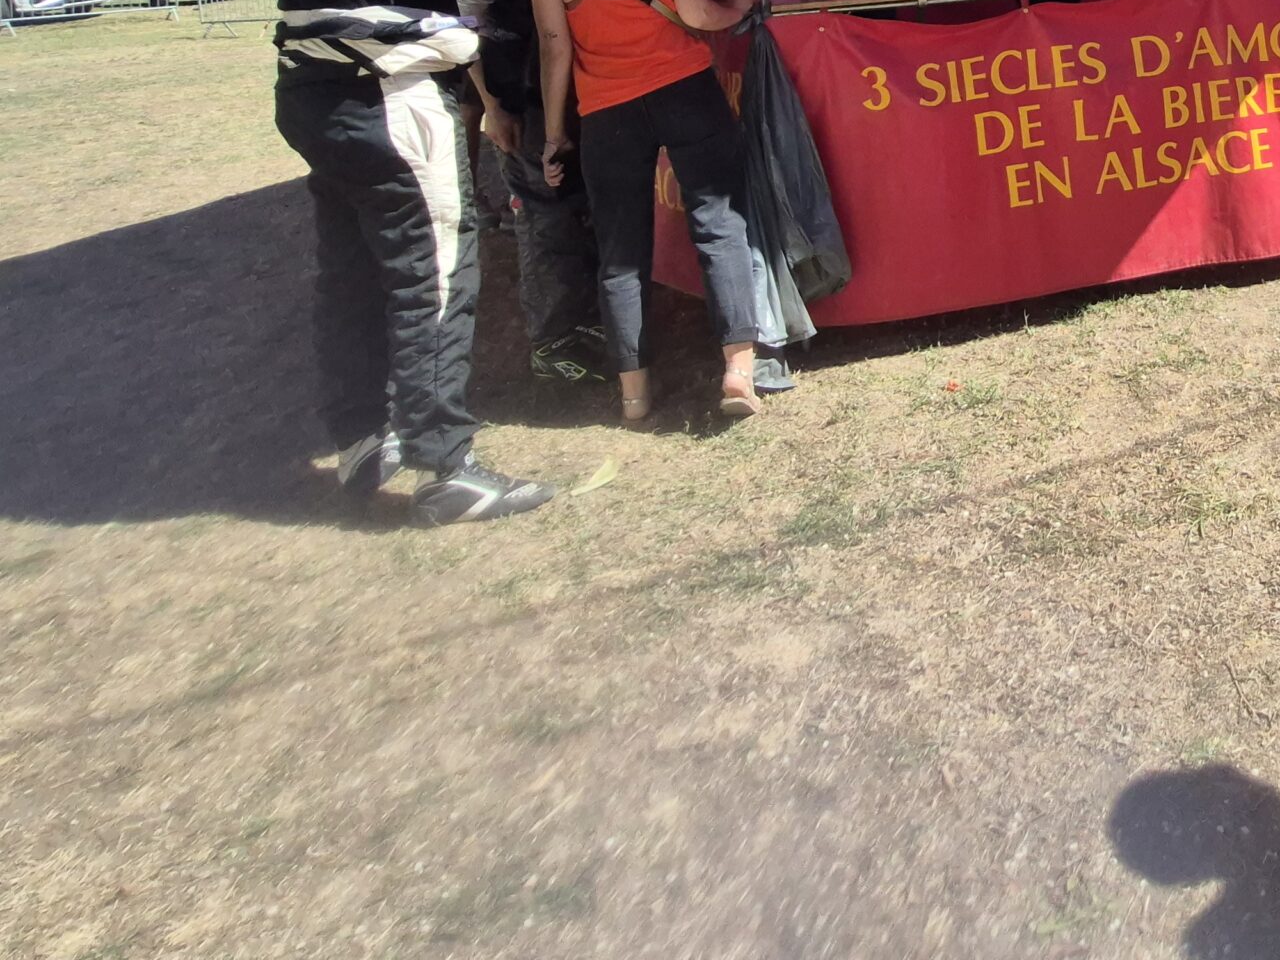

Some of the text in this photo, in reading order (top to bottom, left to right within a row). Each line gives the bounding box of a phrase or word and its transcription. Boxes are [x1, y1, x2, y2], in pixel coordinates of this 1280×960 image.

[861, 66, 891, 111] 3
[916, 42, 1107, 107] SIECLES
[974, 104, 1045, 156] DE
[1073, 94, 1141, 141] LA
[1006, 128, 1273, 208] EN ALSACE
